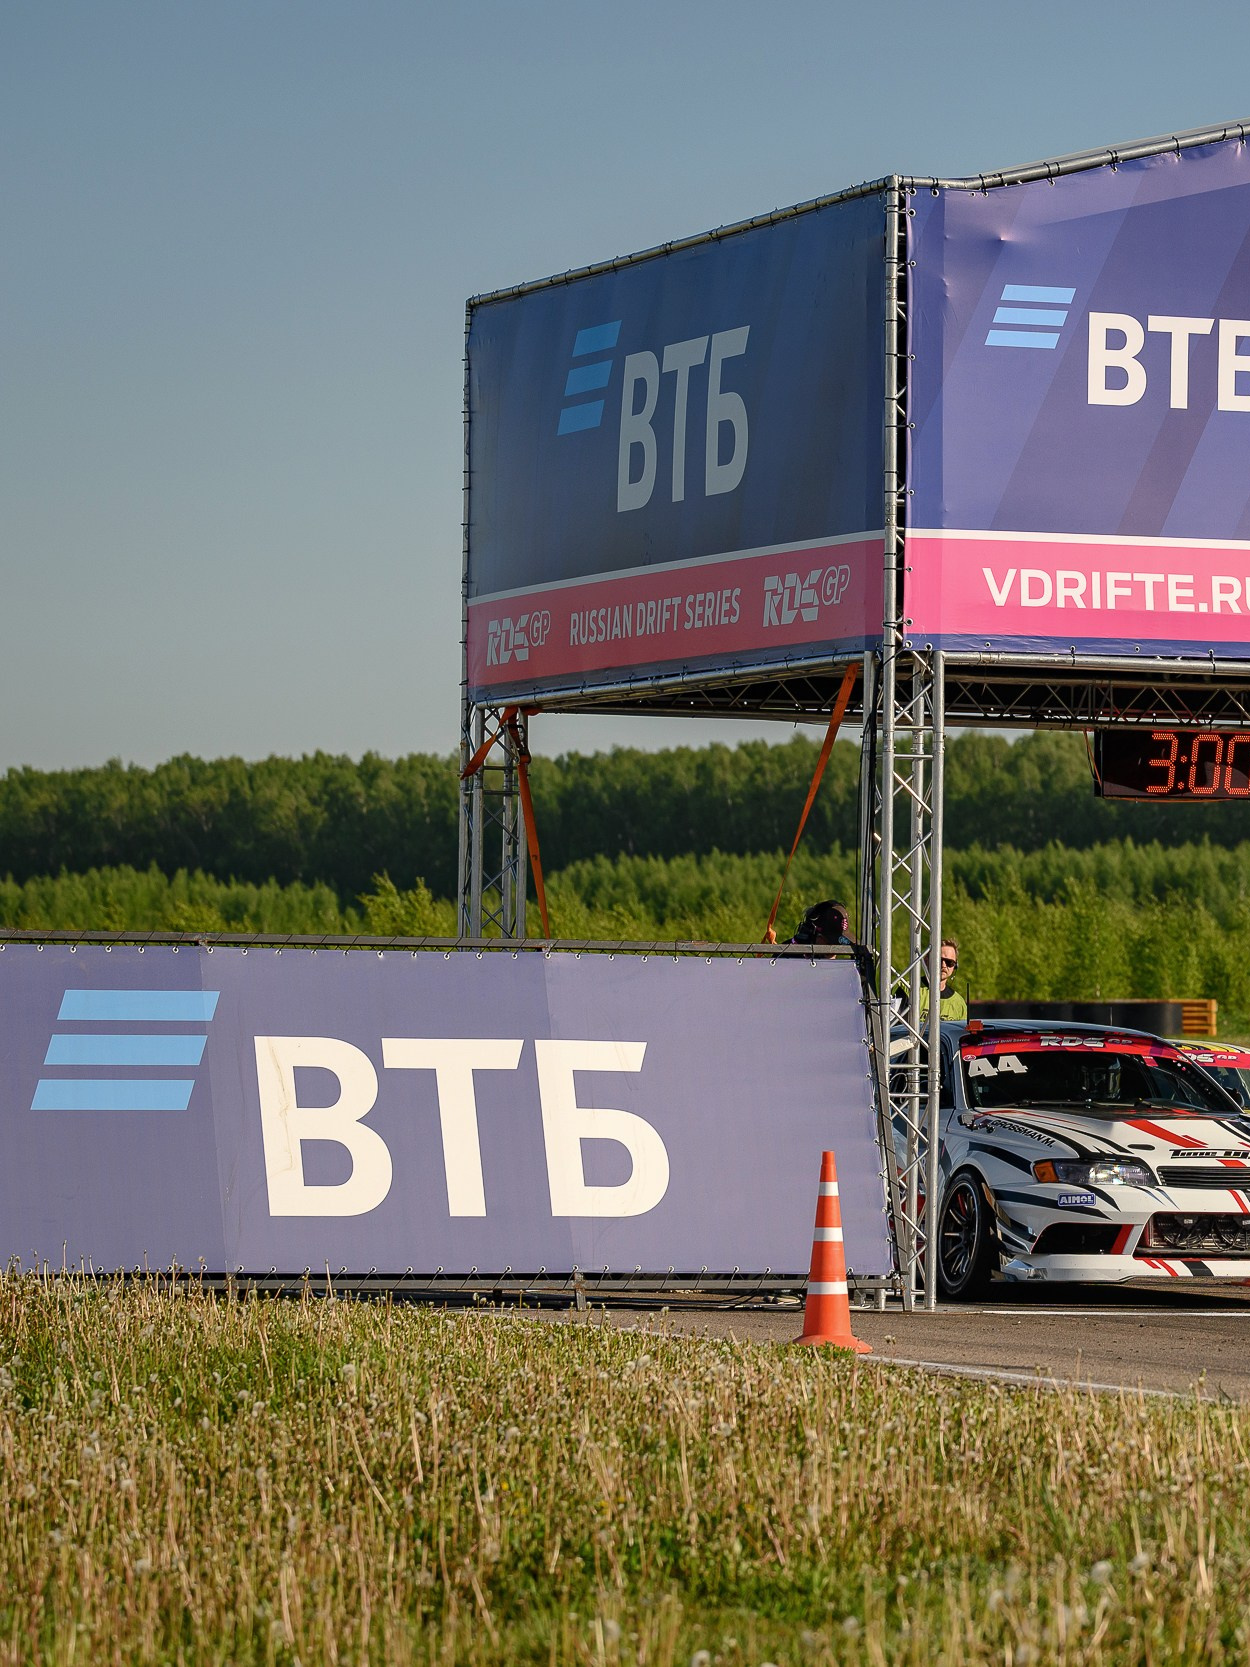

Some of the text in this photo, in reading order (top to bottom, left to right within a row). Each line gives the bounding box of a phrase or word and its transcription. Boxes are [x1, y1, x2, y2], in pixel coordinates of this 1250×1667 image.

[617, 324, 750, 513] ВТБ
[570, 588, 742, 646] RUSSIAN DRIFT SERIES
[762, 564, 851, 627] RDS GP
[487, 610, 551, 667] RDS GP
[968, 1054, 1028, 1078] 44
[1039, 1035, 1105, 1048] RDS
[254, 1036, 671, 1218] ВТБ
[990, 1119, 1044, 1142] GROSSMAN
[1060, 1194, 1094, 1204] AIMOL
